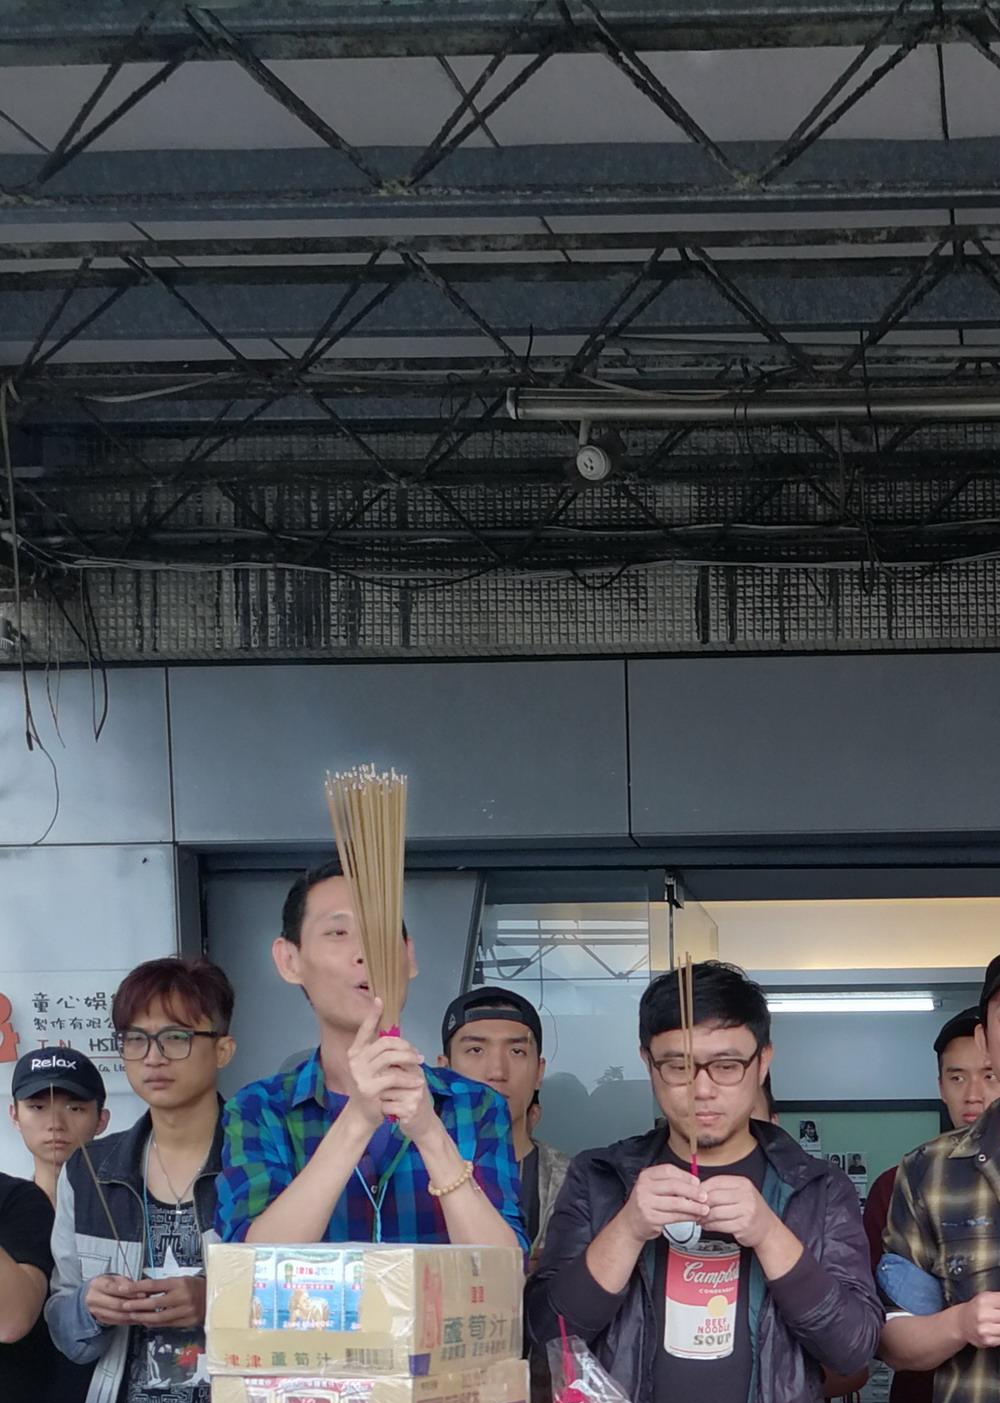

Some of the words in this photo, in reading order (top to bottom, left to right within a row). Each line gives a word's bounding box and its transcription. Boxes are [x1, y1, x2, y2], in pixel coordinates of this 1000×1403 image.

[32, 992, 115, 1013] 童心娛
[705, 1318, 727, 1327] BEEF
[697, 1325, 730, 1334] NOODLE
[693, 1333, 731, 1346] SOUP
